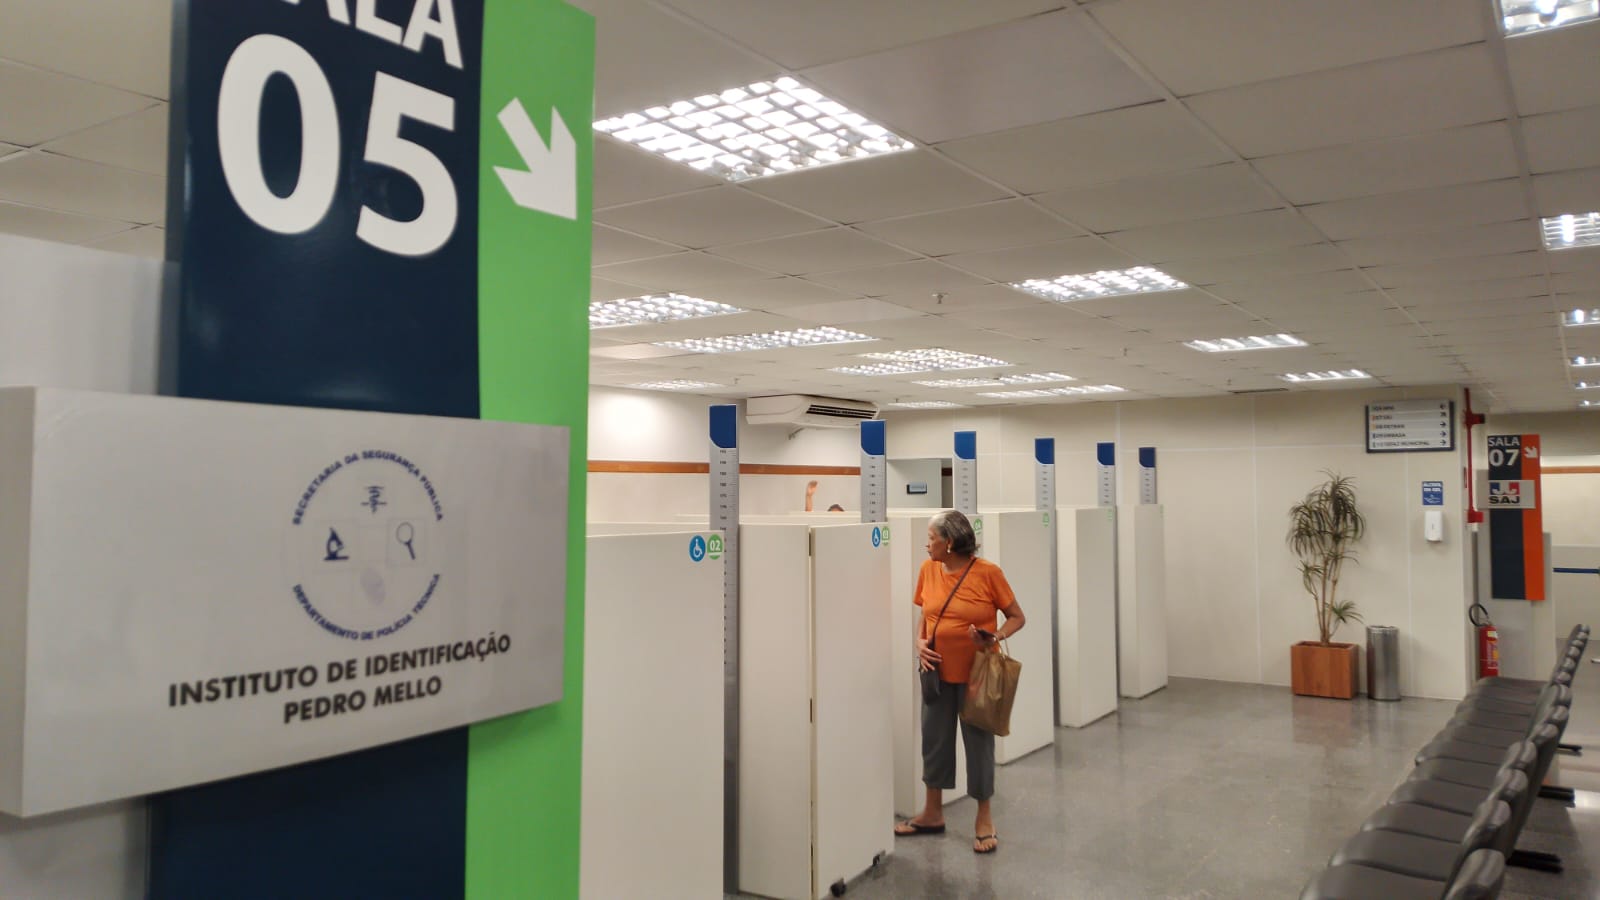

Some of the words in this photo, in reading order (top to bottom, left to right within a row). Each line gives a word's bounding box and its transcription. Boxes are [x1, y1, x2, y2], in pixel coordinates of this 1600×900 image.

[216, 33, 459, 257] 05
[1488, 437, 1520, 447] SALA
[1489, 448, 1520, 467] 07
[293, 461, 343, 525] SECRETARIA
[344, 453, 360, 465] DA
[362, 450, 420, 478] SEGURANÇA
[1489, 496, 1520, 504] SAJ
[710, 540, 721, 551] 02
[292, 583, 359, 641] DEPARTAMENTO
[360, 631, 374, 641] DE
[168, 664, 319, 708] INSTITUTO
[327, 658, 358, 684] DE
[364, 632, 512, 678] IDENTIFICAÇÃO
[283, 689, 367, 724] PEDRO
[372, 675, 443, 708] MELLO
